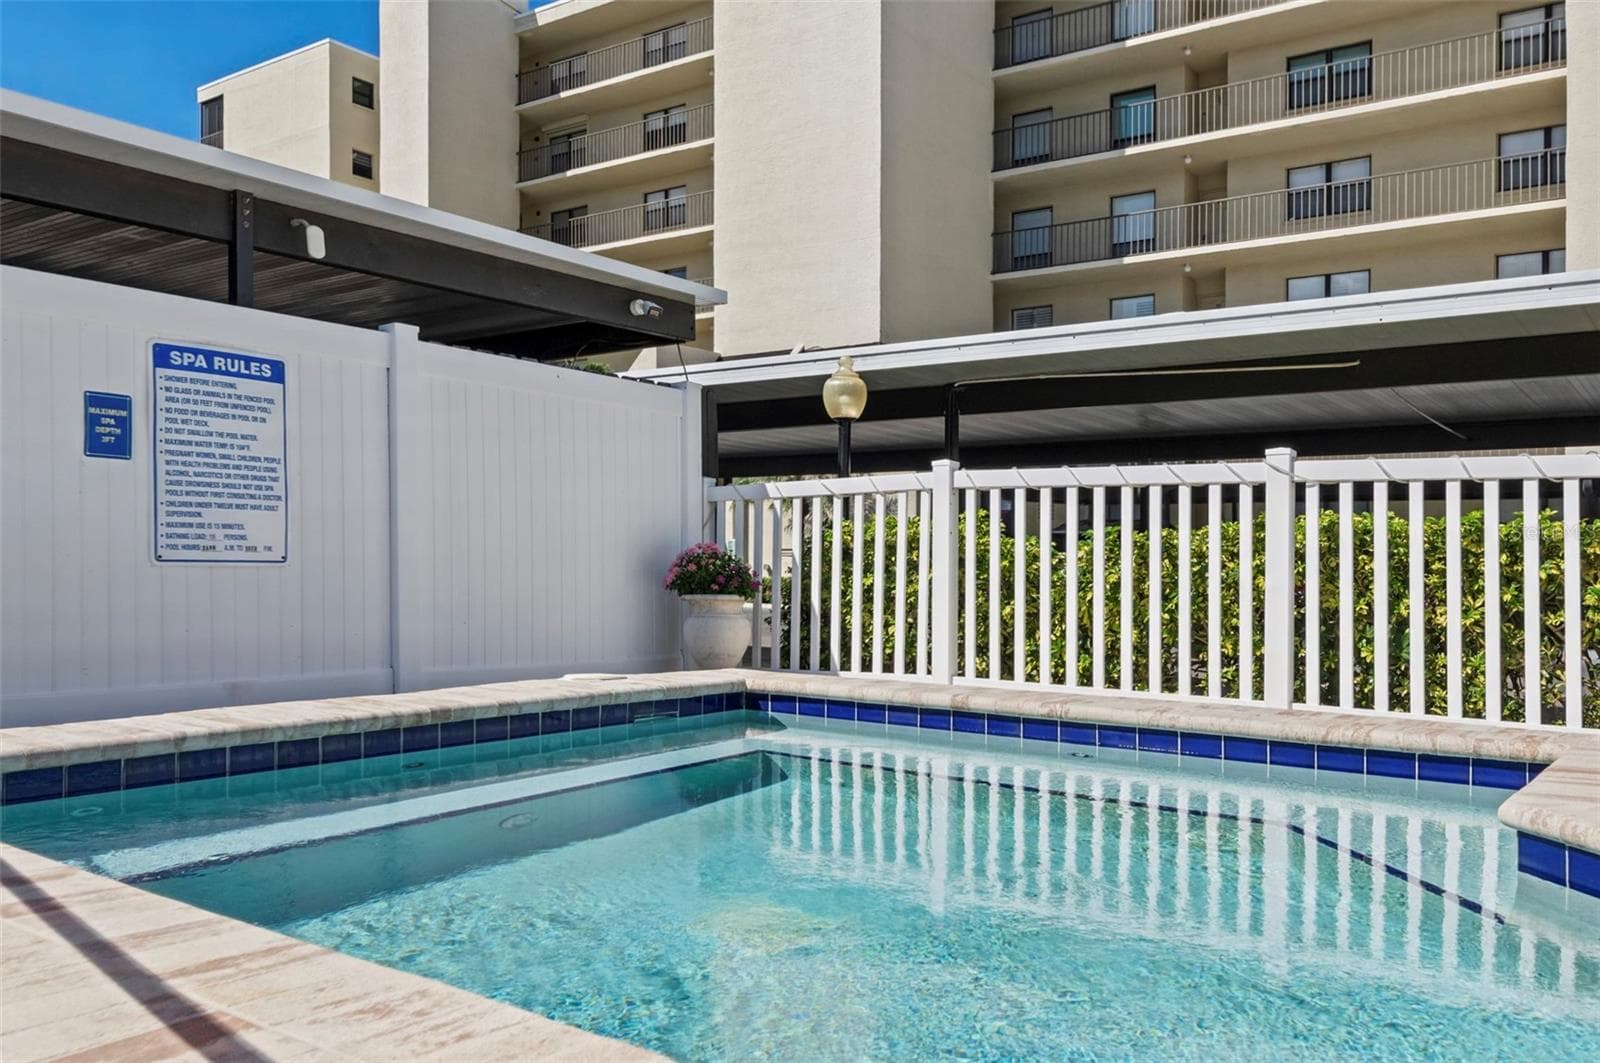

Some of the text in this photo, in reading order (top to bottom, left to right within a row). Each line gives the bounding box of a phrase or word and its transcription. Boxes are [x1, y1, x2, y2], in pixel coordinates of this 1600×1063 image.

[170, 350, 272, 377] SPA RULES
[164, 374, 187, 383] SHOWER
[190, 377, 209, 386] BEFORE
[202, 390, 225, 398] ANIMALS
[165, 395, 179, 403] AREA
[230, 403, 255, 412] UNFENCED
[88, 406, 128, 416] MAXIMUM
[199, 410, 229, 419] BEVERAGES
[187, 428, 213, 437] SWALLOW
[164, 438, 192, 446] MAXIMUM
[164, 449, 193, 457] PREGNANT
